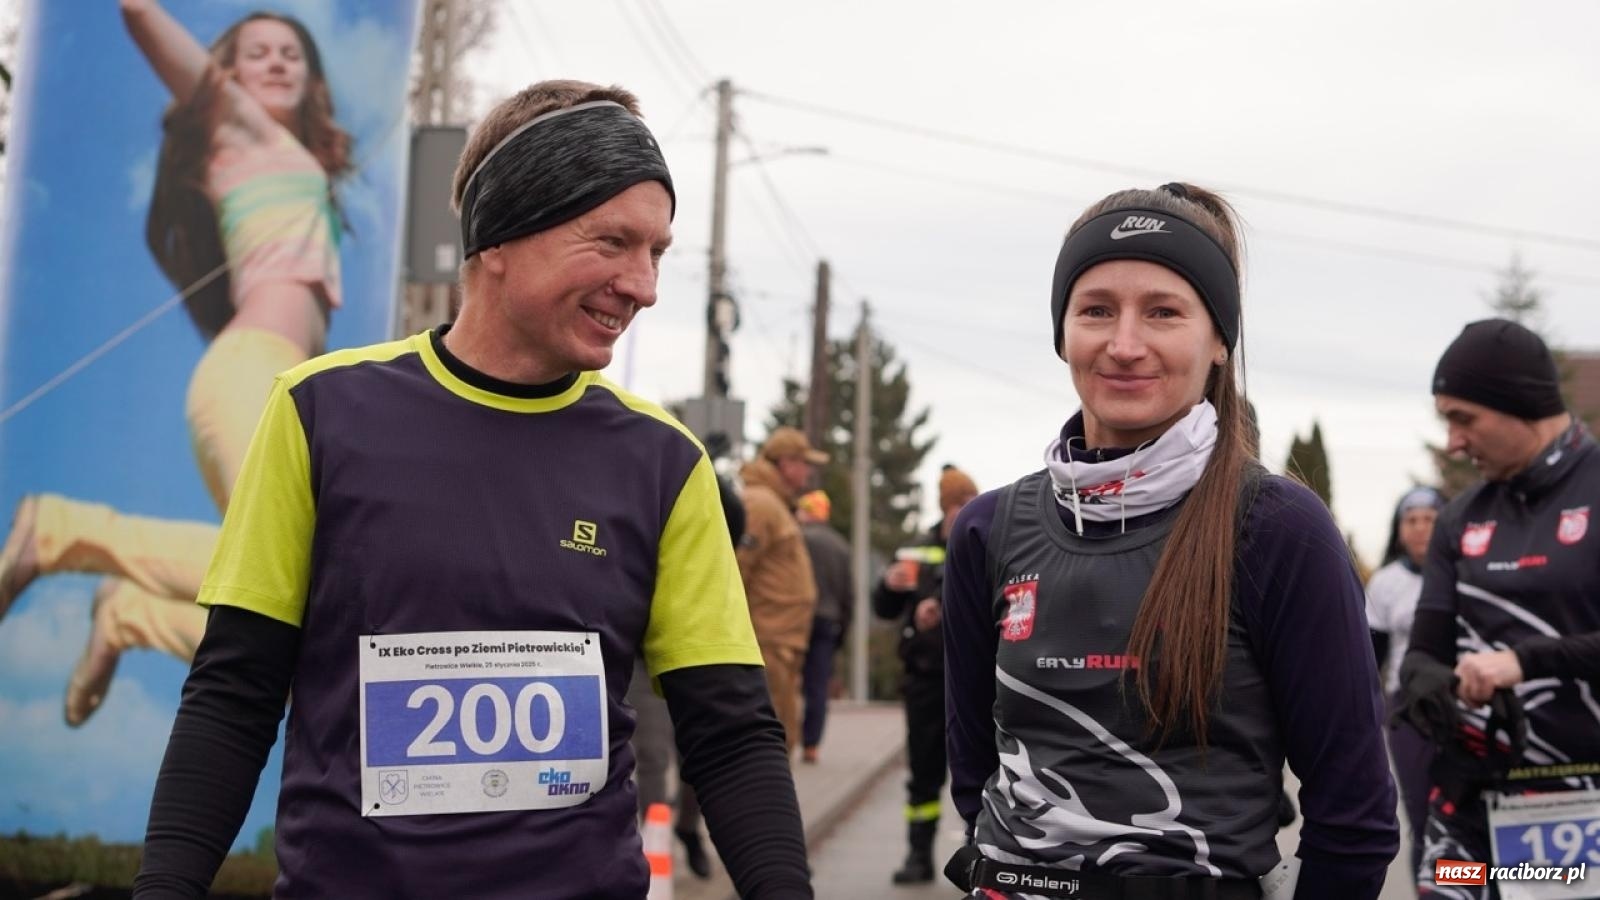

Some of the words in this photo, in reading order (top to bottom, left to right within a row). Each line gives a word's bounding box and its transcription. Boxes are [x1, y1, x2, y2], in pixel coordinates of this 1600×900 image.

[1120, 215, 1166, 231] RUN
[378, 646, 391, 658] IX
[392, 646, 415, 657] Eko
[416, 645, 452, 656] Cross
[454, 645, 470, 657] po
[471, 641, 506, 654] Ziemi
[507, 641, 585, 656] Pietrowickiej
[406, 681, 566, 758] 200
[538, 767, 571, 785] eko
[1020, 873, 1080, 895] Kalenji
